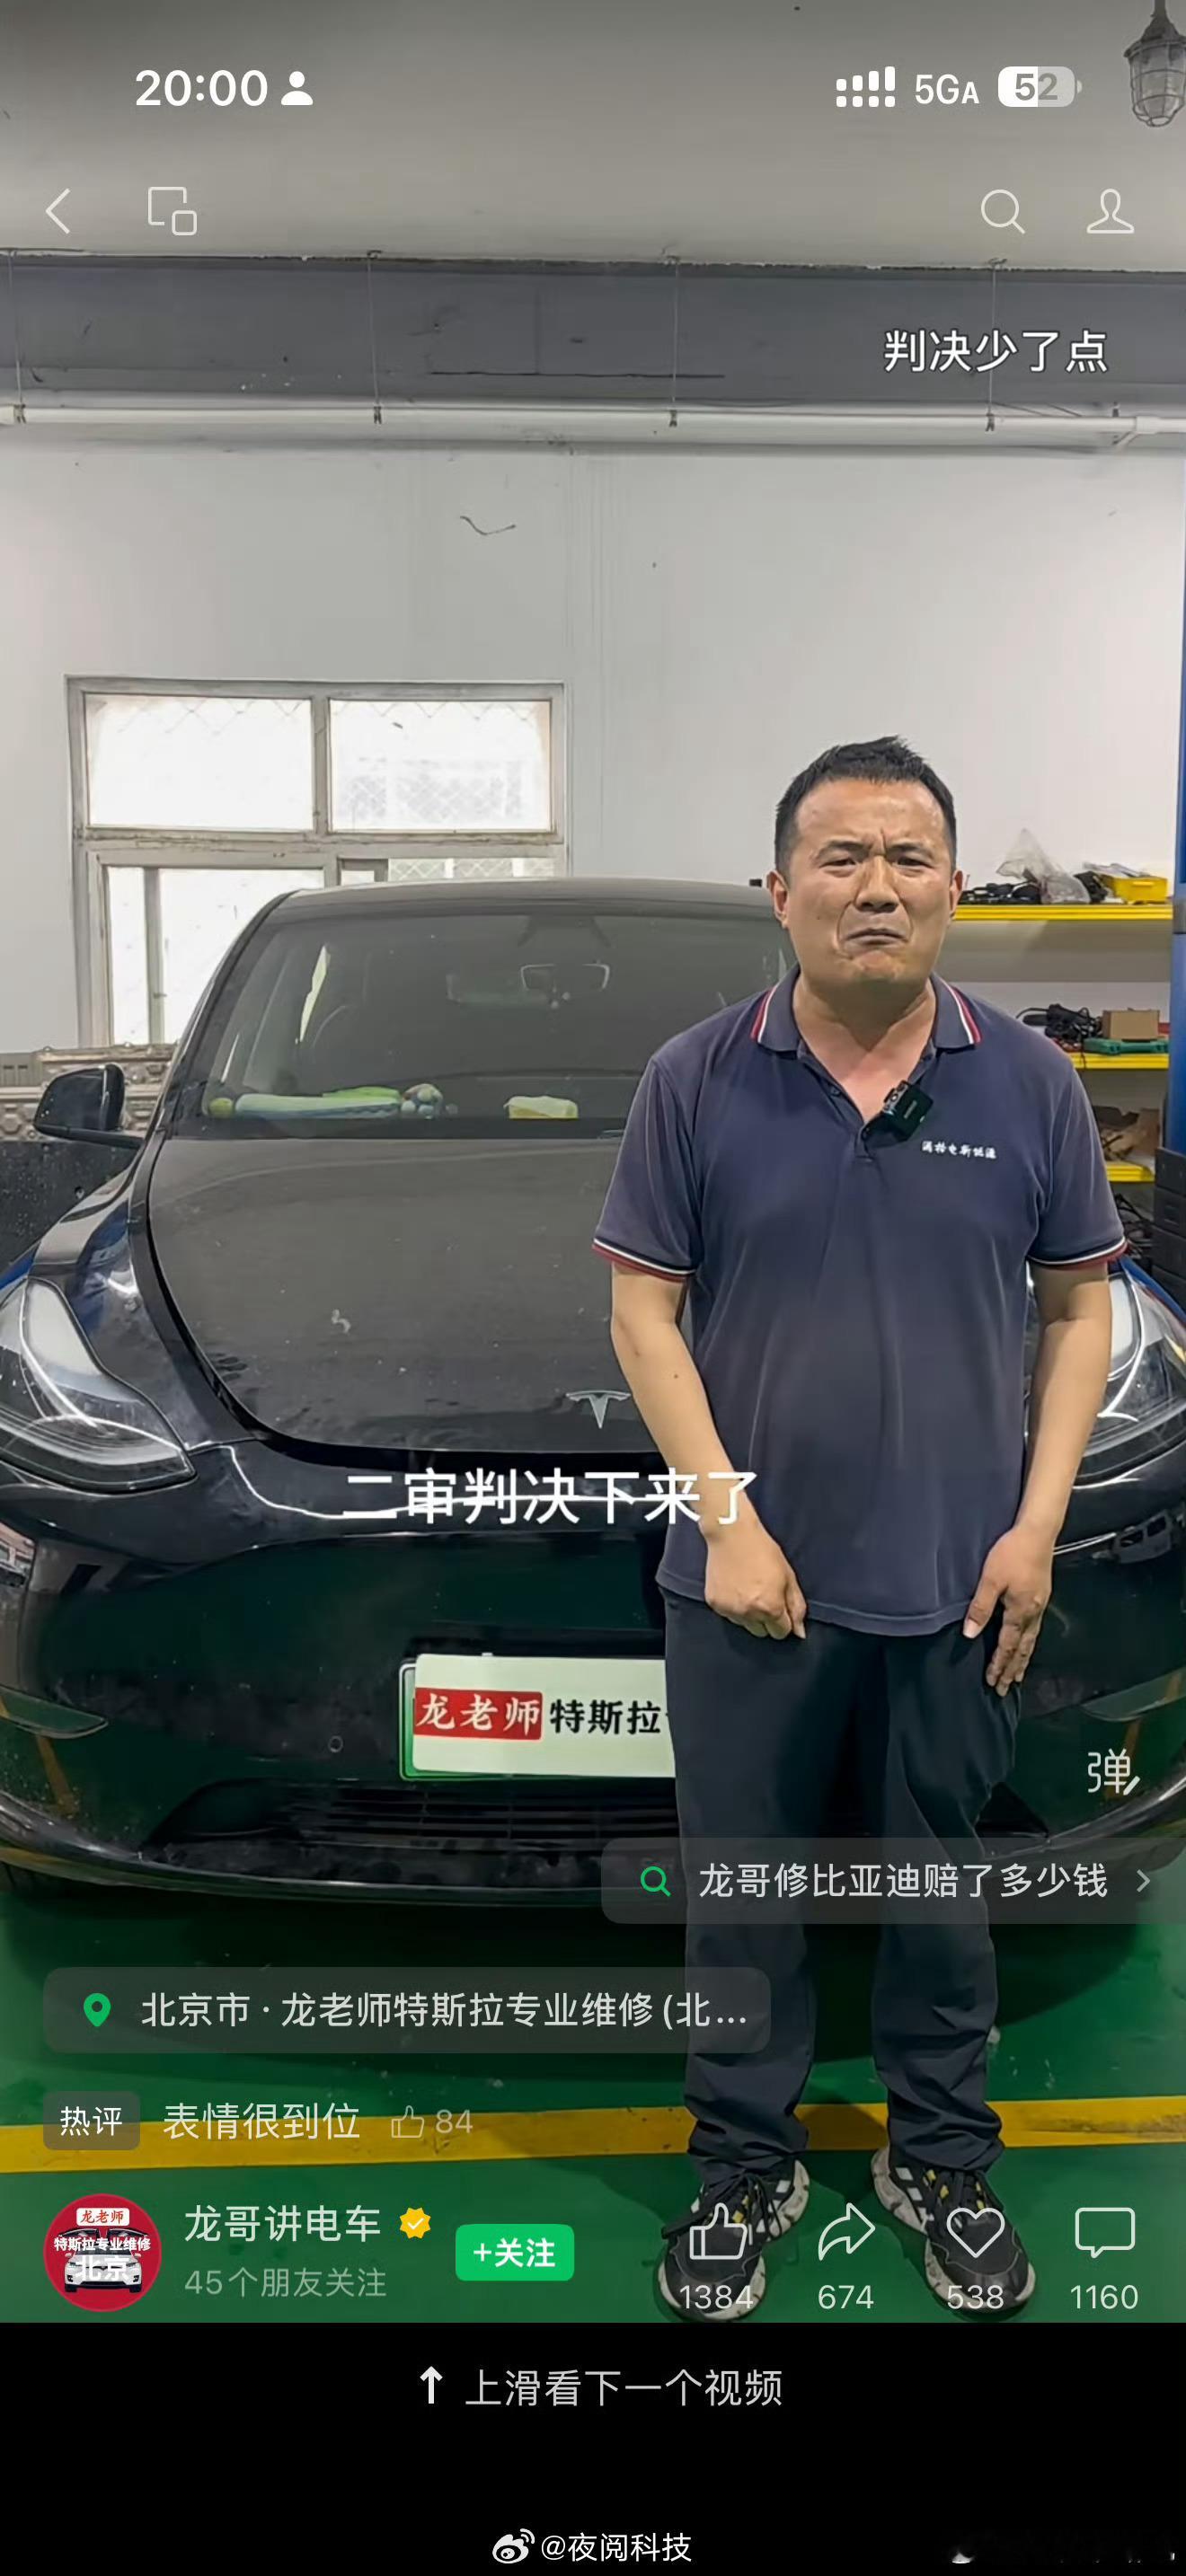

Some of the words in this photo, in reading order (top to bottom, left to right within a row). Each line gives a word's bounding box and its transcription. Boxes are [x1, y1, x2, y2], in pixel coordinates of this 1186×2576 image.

[415, 1692, 540, 1736] 龙老师
[549, 1698, 669, 1734] 特斯拉
